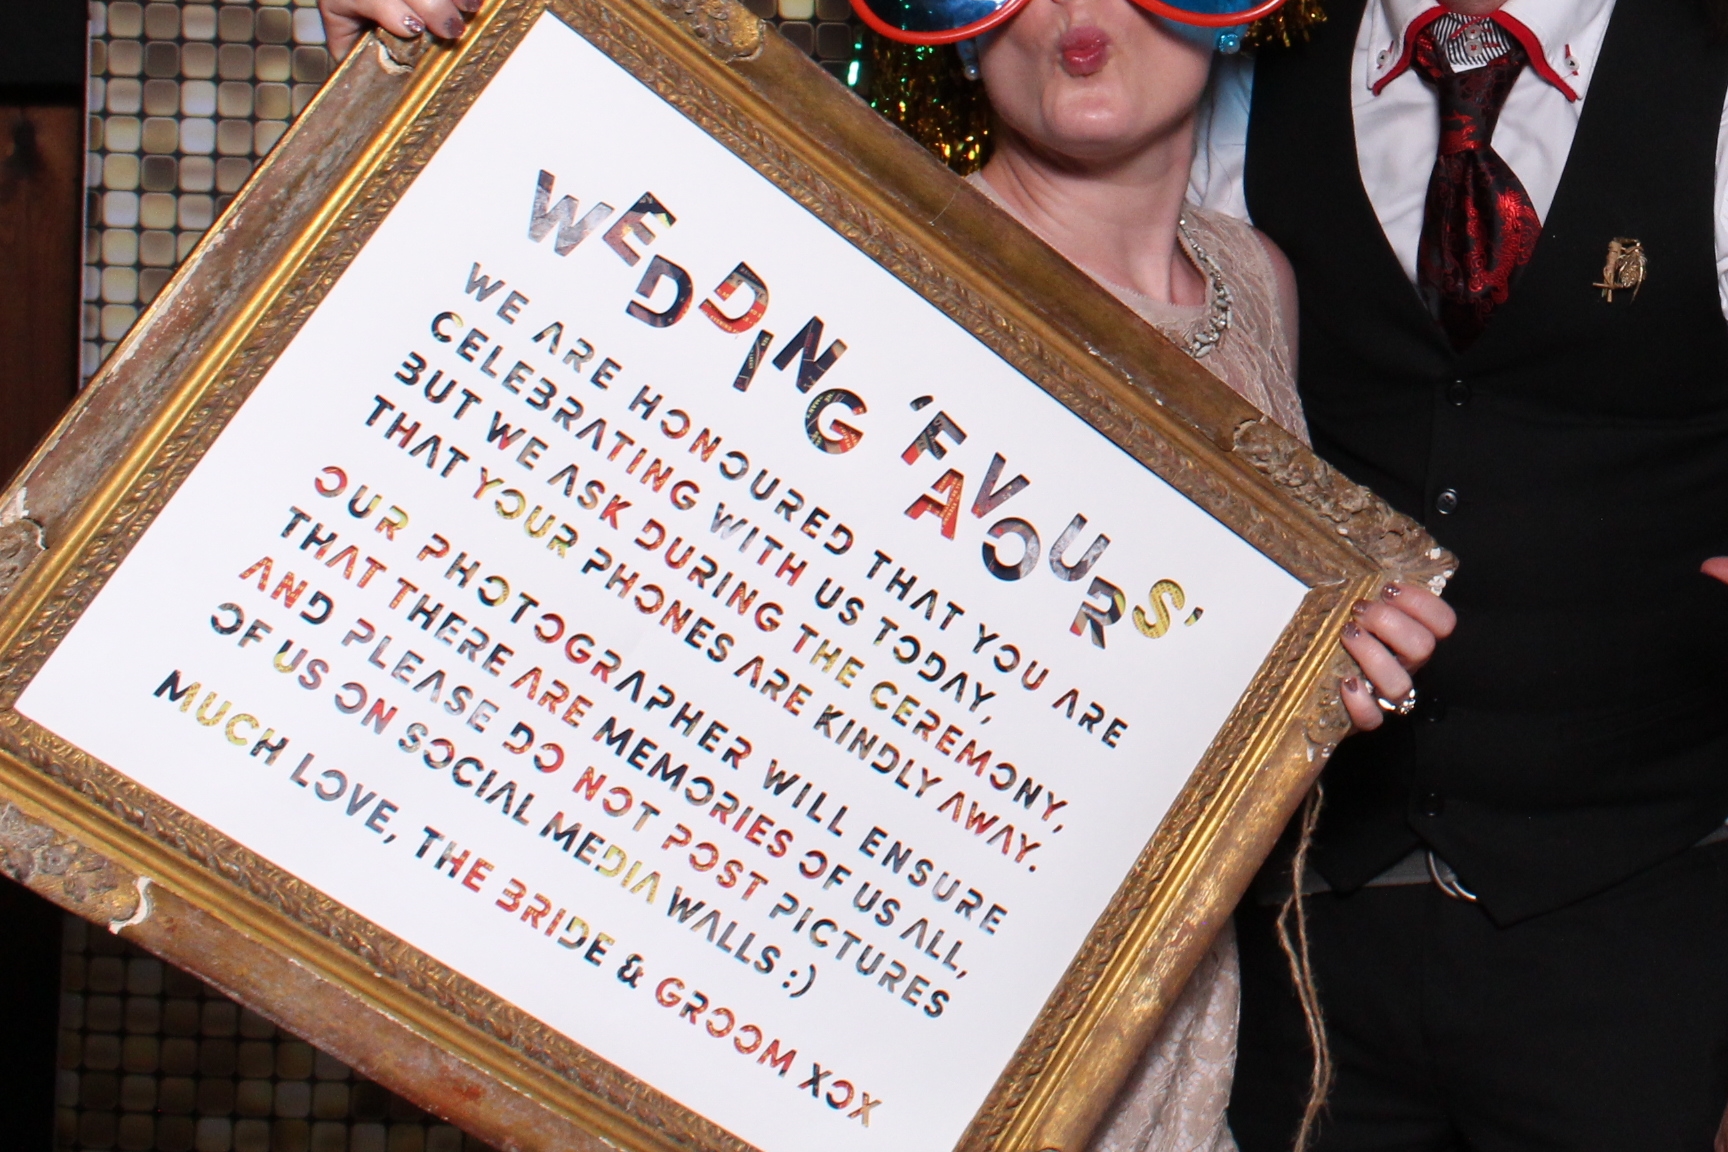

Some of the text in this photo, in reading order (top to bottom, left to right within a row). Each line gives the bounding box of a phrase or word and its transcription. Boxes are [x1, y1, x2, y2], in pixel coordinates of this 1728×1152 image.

[430, 311, 998, 726] CELEBRATING WITH US TODAY,
[464, 261, 1129, 750] WE ARE HONOURED THAT YOU ARE
[528, 169, 868, 455] WEDDING
[209, 602, 817, 999] OF US ON SOCIAL MEDIA WALLS :)
[238, 556, 951, 1019] AND PLEASE DO NOT POST PICTURES
[279, 505, 968, 980] THAT THERE ARE MEMORIES OF US ALL,
[314, 465, 1009, 936] OUR PHOTOGRAPHER WILL ENSURE
[364, 394, 1042, 873] THAT YOUR PHONES ARE KINDLY AWAY.
[393, 351, 1069, 834] BUT WE ASK DURING THE CEREMONY,
[152, 669, 883, 1128] MUCH LOVE, THE BRIDE & GROOM XOX
